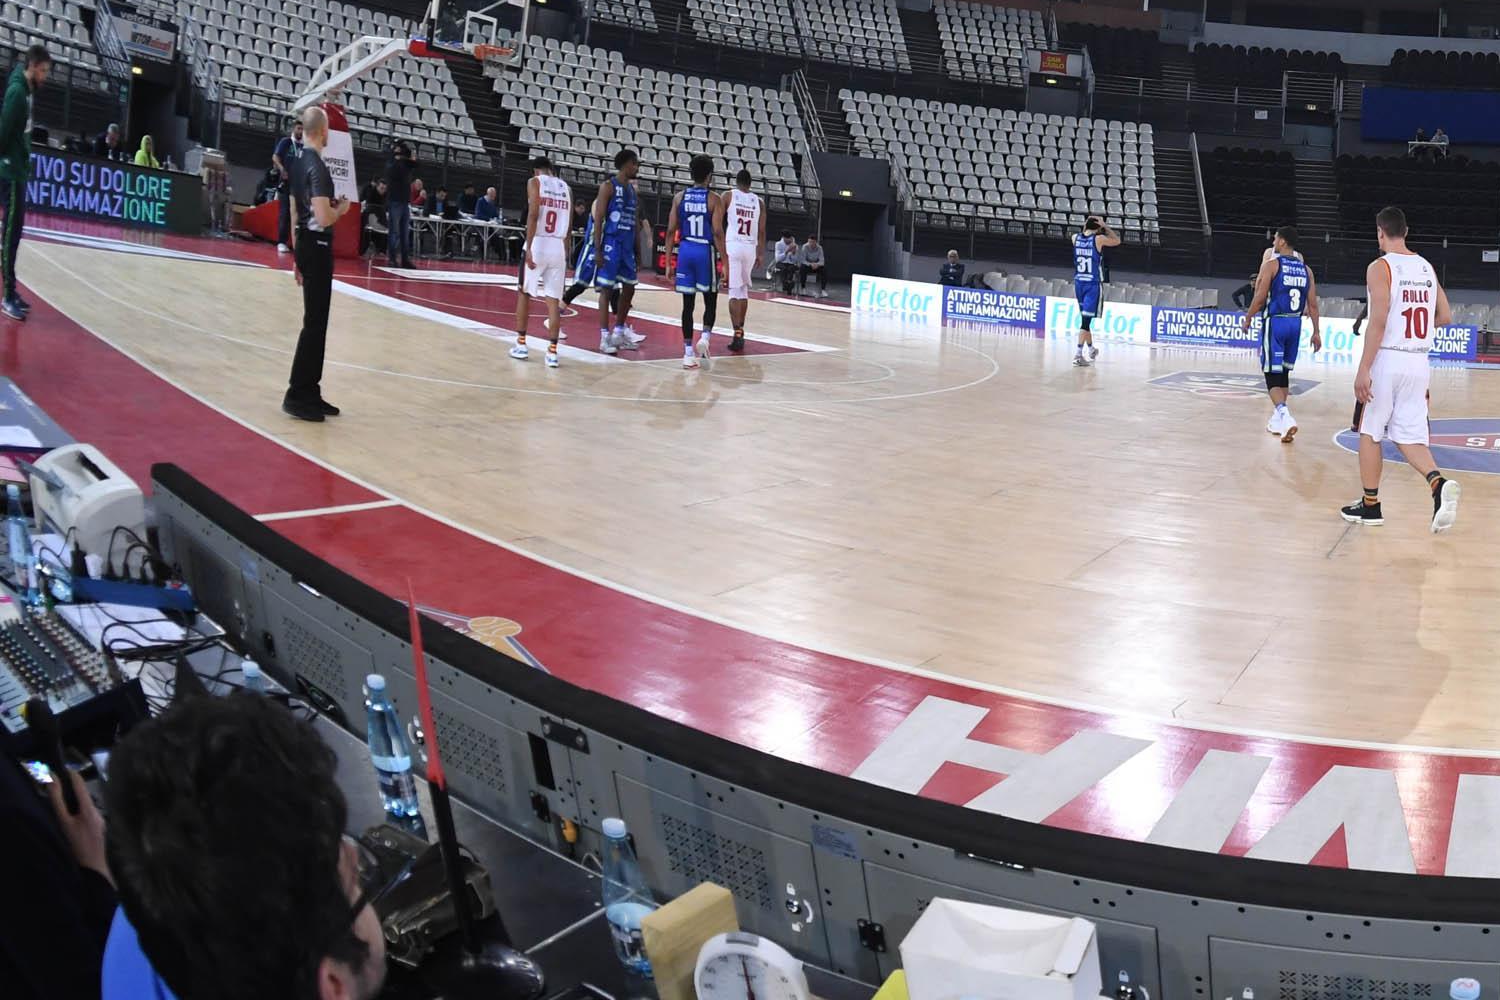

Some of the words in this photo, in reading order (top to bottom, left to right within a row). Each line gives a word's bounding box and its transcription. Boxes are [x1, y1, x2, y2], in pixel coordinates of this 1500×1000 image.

[70, 161, 95, 188] SU
[100, 167, 172, 201] DOLORE
[616, 186, 624, 197] 21
[25, 181, 166, 225] NFIAMMAZIONE
[684, 202, 707, 213] EVANS
[545, 211, 557, 233] 9
[736, 208, 754, 219] WHITE
[688, 214, 704, 237] 11
[737, 218, 752, 237] 21
[1077, 256, 1092, 273] 31
[1283, 275, 1307, 287] SMITH
[856, 280, 933, 313] Flector
[947, 290, 981, 304] ATTIVO
[983, 293, 999, 305] SU
[999, 294, 1041, 311] DOLORE
[1289, 288, 1301, 311] 3
[1402, 289, 1429, 303] RULLO
[947, 302, 954, 312] E
[955, 303, 1037, 322] INFIAMMAZIONE
[1051, 308, 1142, 335] Flctor
[1157, 310, 1196, 324] ATTIVO
[1197, 312, 1214, 325] SU
[1157, 322, 1164, 334] E
[1166, 323, 1259, 341] INFIAMMAZIONE
[1401, 307, 1428, 339] 10
